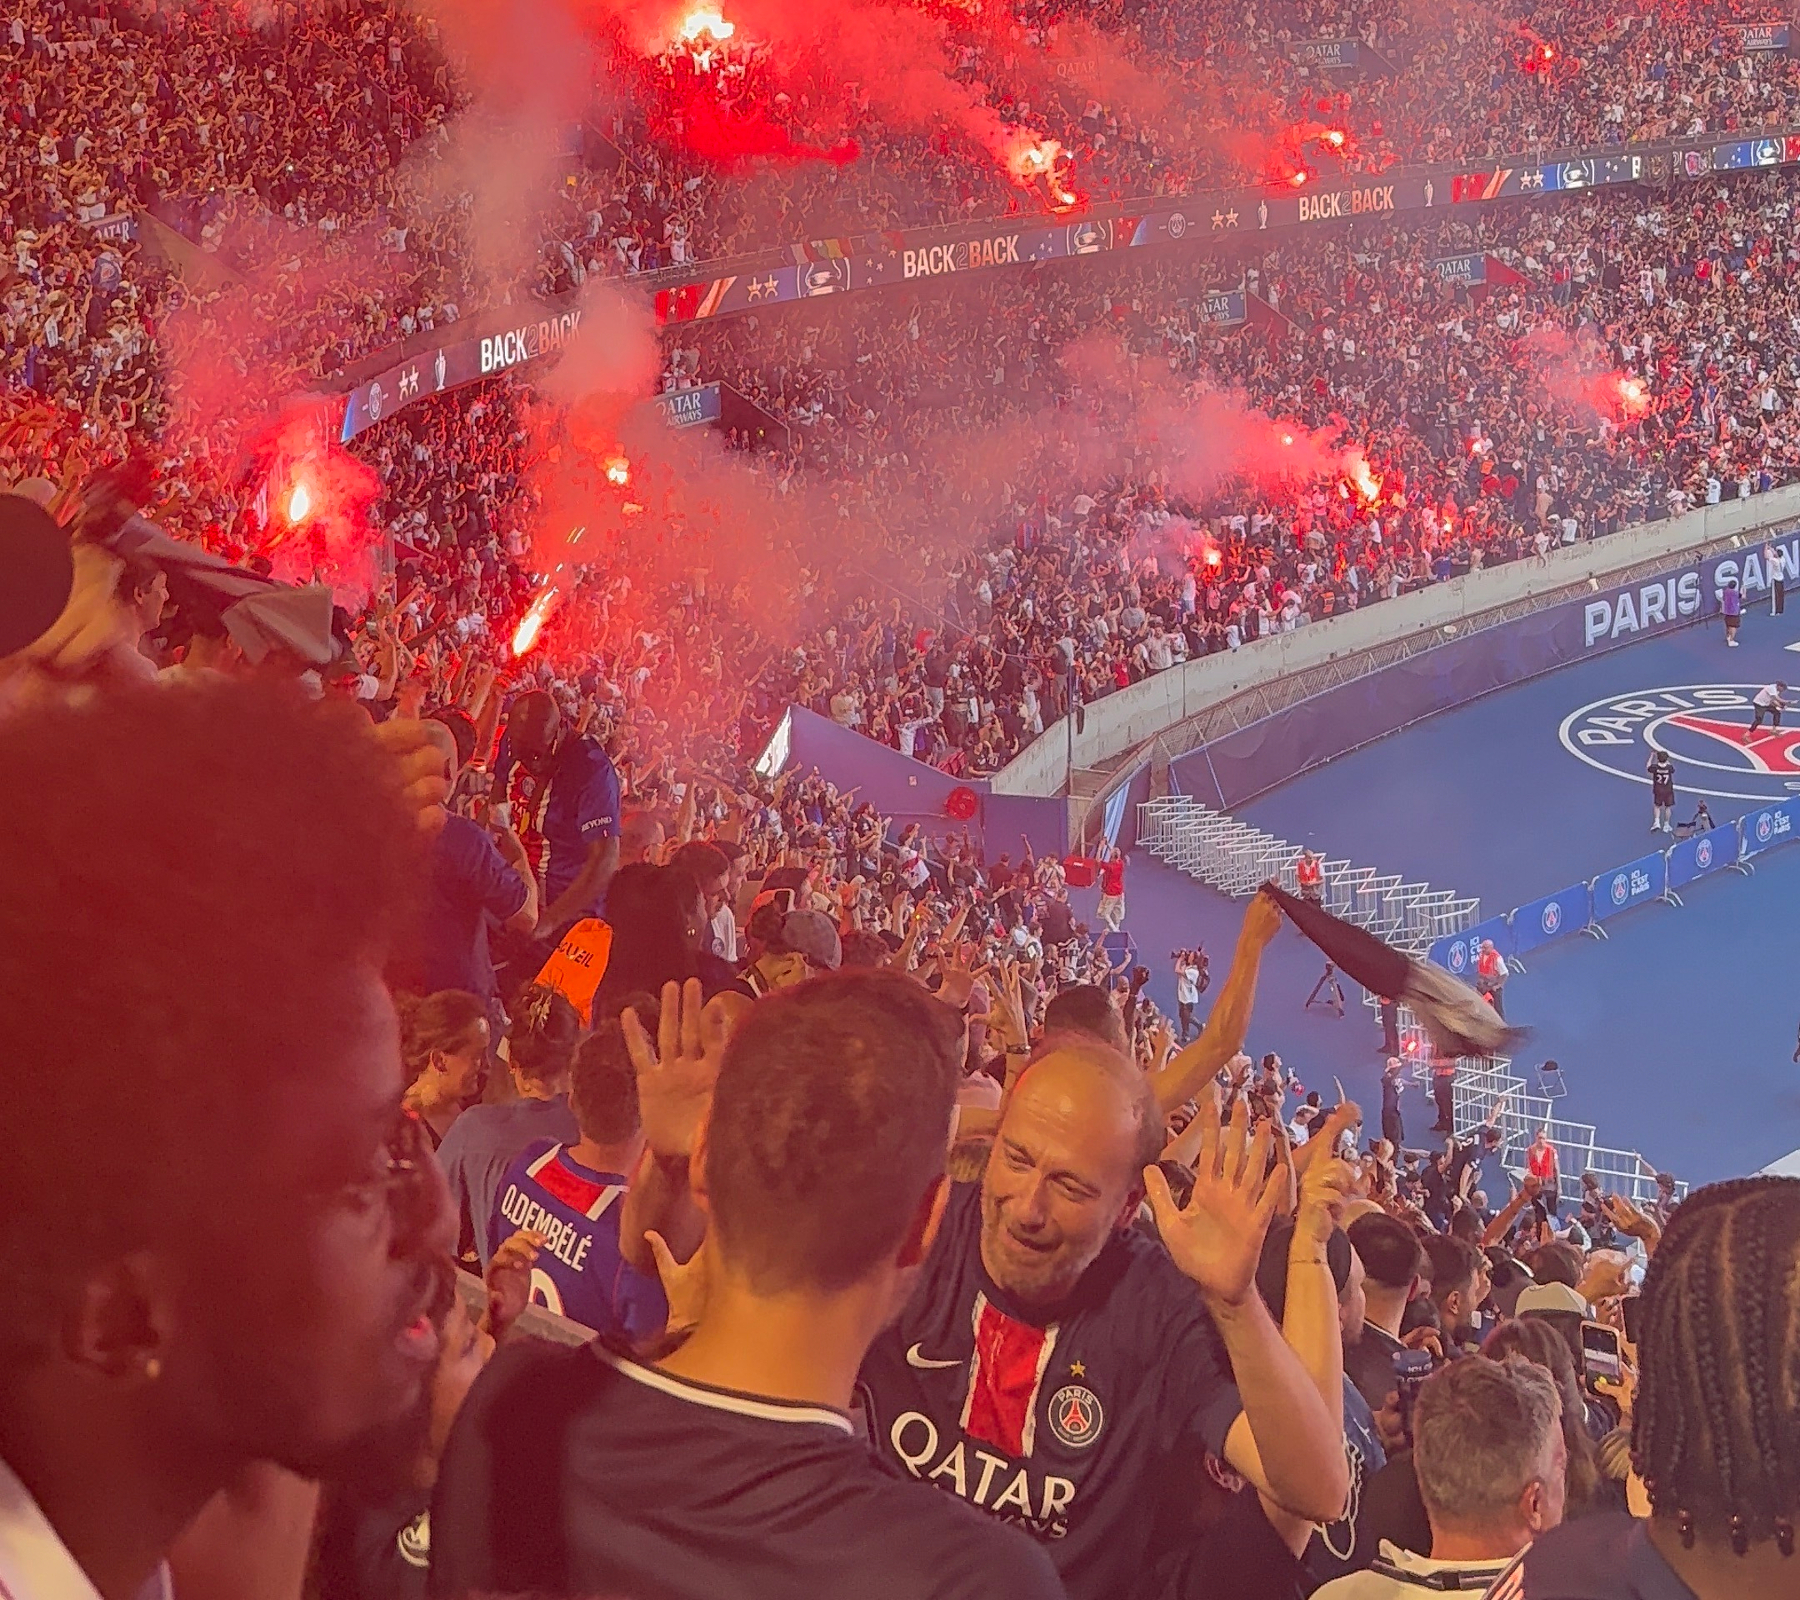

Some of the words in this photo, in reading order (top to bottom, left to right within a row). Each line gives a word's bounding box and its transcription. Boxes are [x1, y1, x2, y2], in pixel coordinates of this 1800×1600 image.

[1056, 60, 1096, 79] QATAR
[1299, 185, 1395, 221] BACK2BACK
[903, 234, 1020, 279] BACK2BACK
[1436, 258, 1471, 278] QATAR
[480, 309, 581, 374] BACK2BACK
[1584, 571, 1701, 648] PARIS
[1714, 539, 1800, 605] SAN
[1577, 689, 1750, 746] PARIS
[1656, 774, 1670, 786] 27
[501, 1183, 594, 1272] O.DEMBÉLÉ
[1057, 1388, 1094, 1406] PARIS
[890, 1411, 1076, 1520] QATAR
